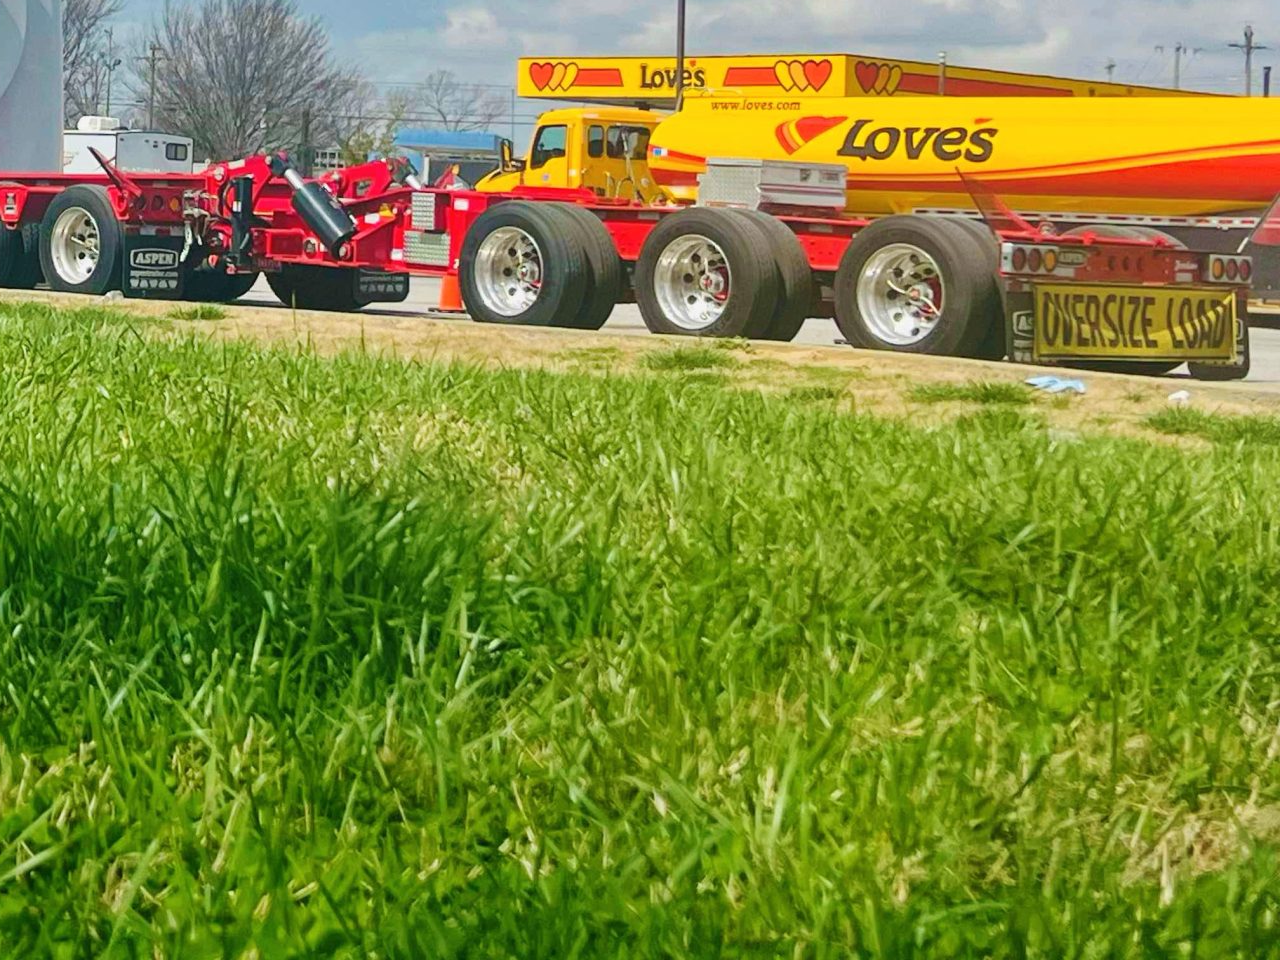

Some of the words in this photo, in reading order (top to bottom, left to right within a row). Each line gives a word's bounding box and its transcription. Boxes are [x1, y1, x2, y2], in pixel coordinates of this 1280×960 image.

[711, 99, 800, 111] www.loves.com
[837, 118, 999, 163] Love's
[135, 252, 174, 265] ASPEN
[1042, 291, 1159, 348] OVERSIZE
[1166, 296, 1228, 350] LOAD
